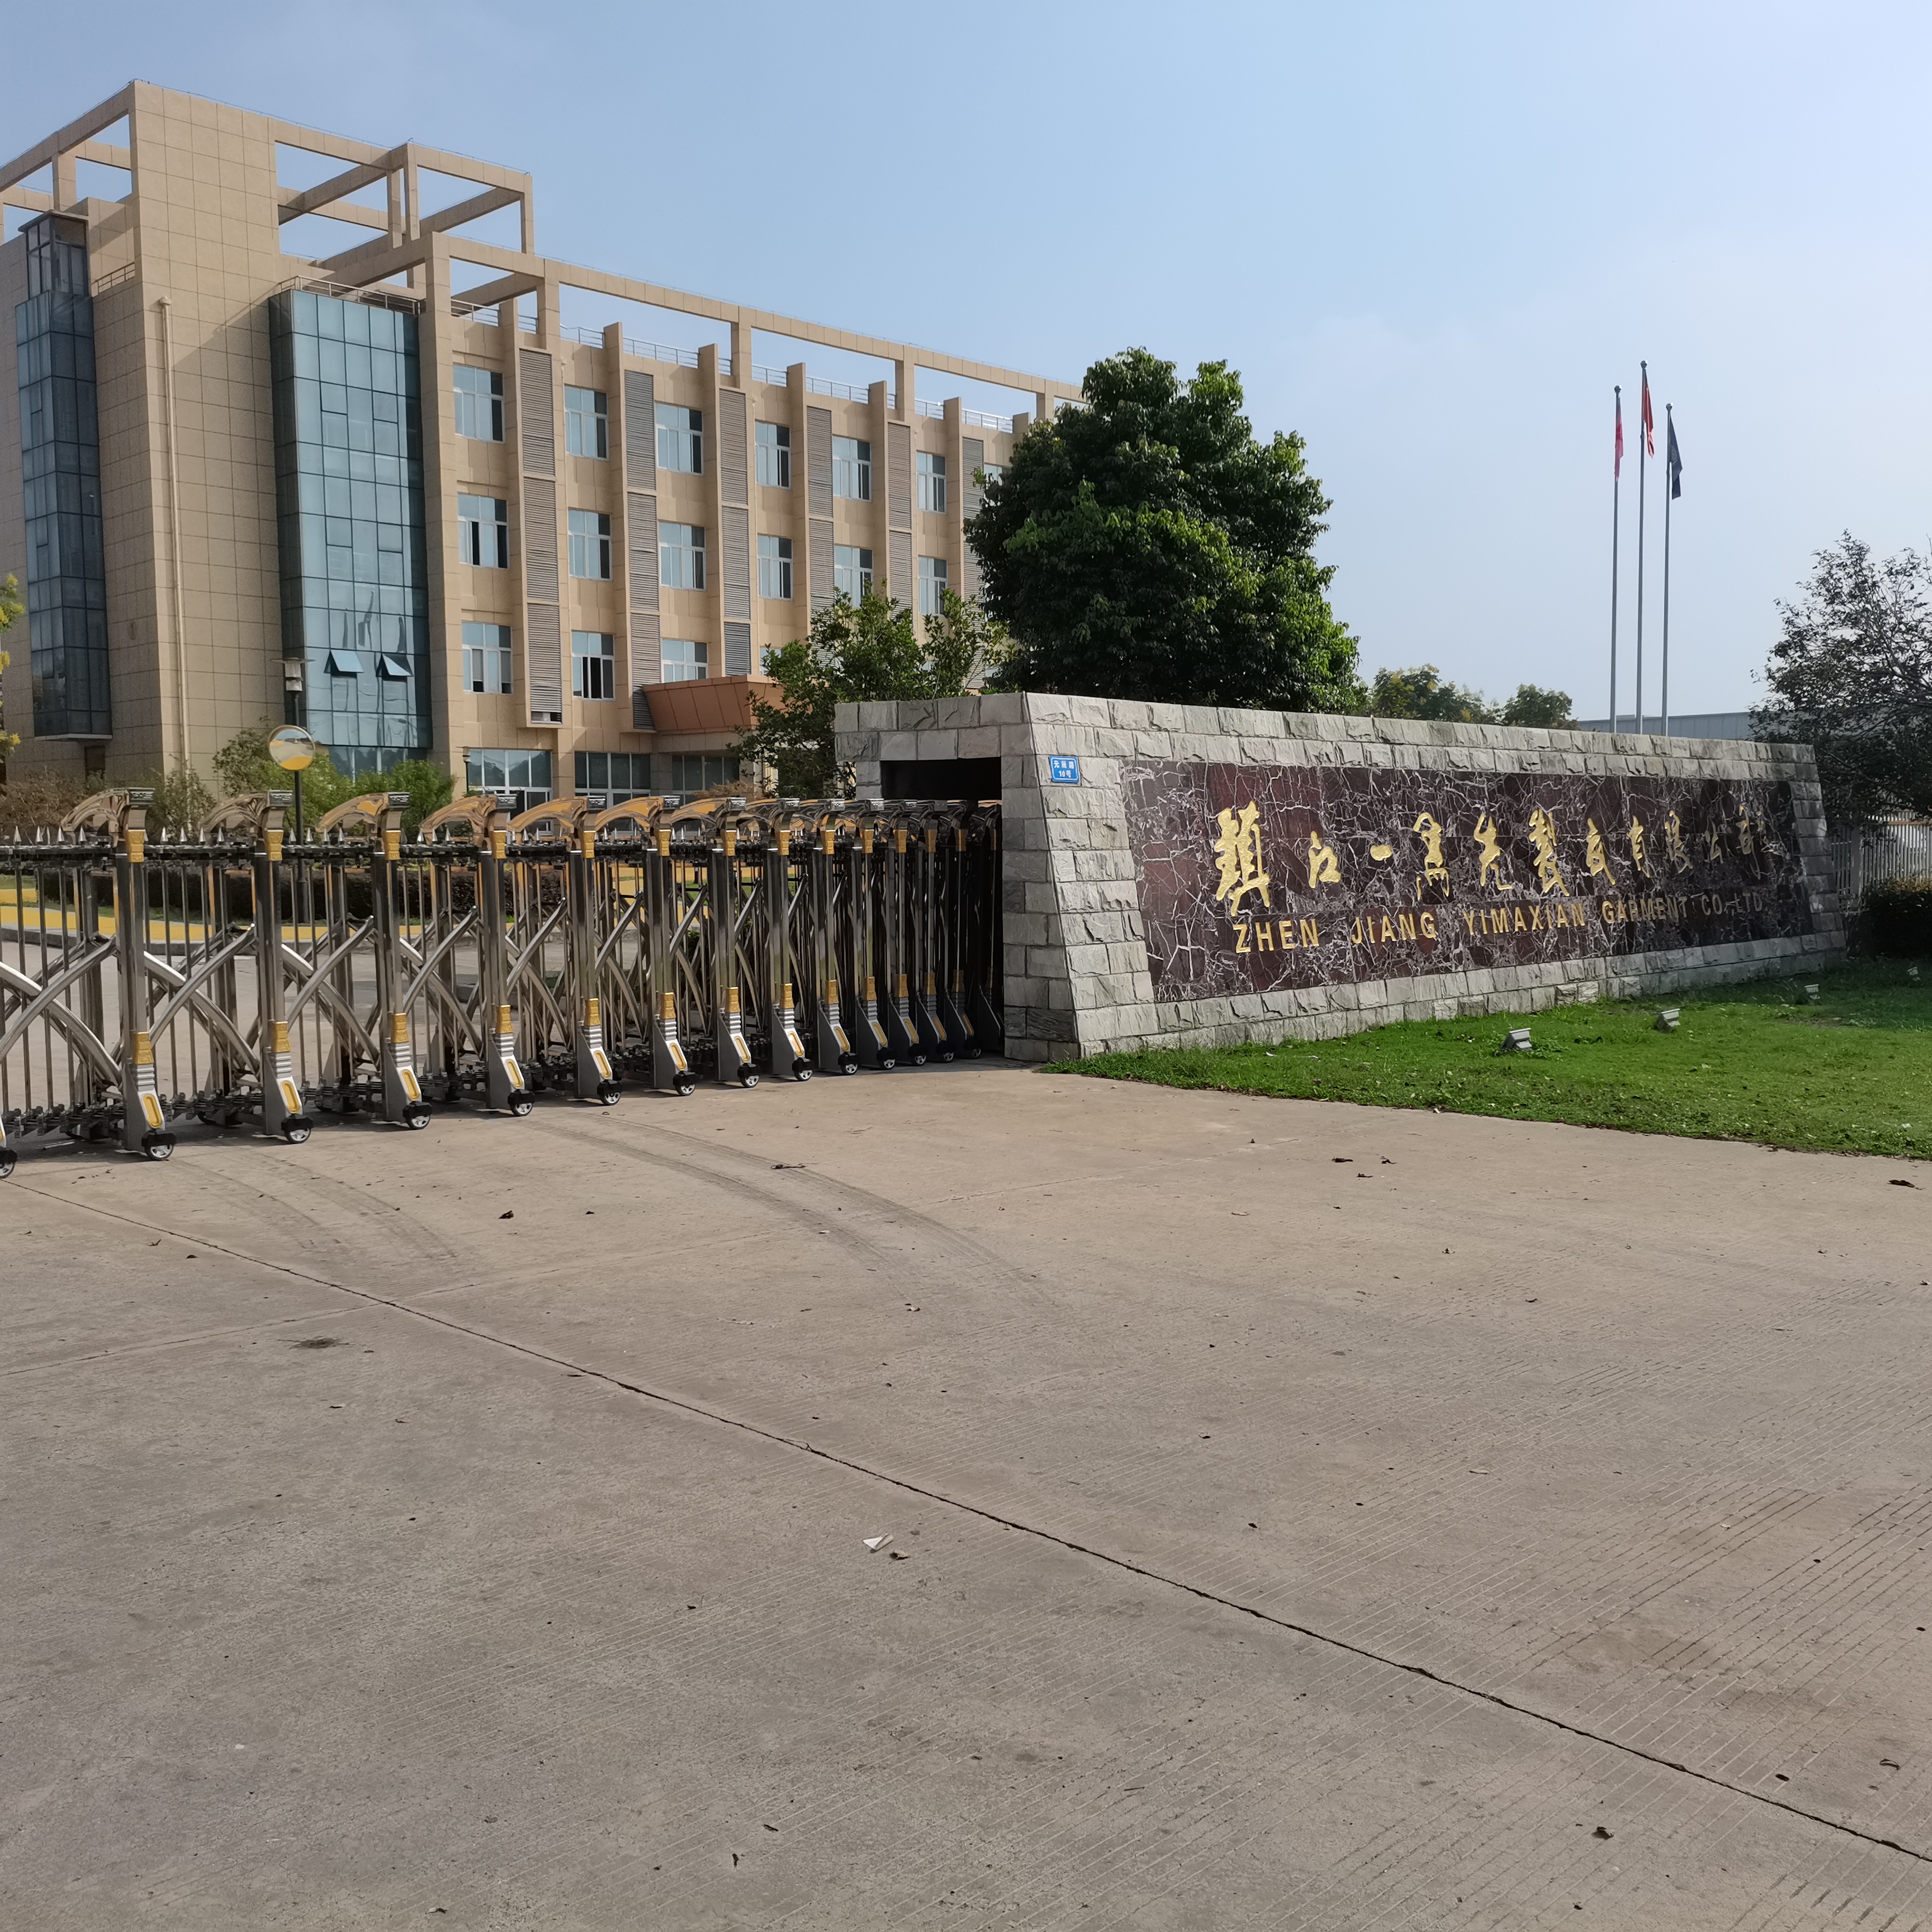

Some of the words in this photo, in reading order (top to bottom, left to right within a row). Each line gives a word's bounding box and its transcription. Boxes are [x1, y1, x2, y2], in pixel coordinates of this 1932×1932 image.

[1232, 918, 1320, 954] ZHEN
[1351, 911, 1437, 944] JIANG
[1462, 902, 1586, 936] YIMAXIAN
[1602, 897, 1688, 924] GARMENT
